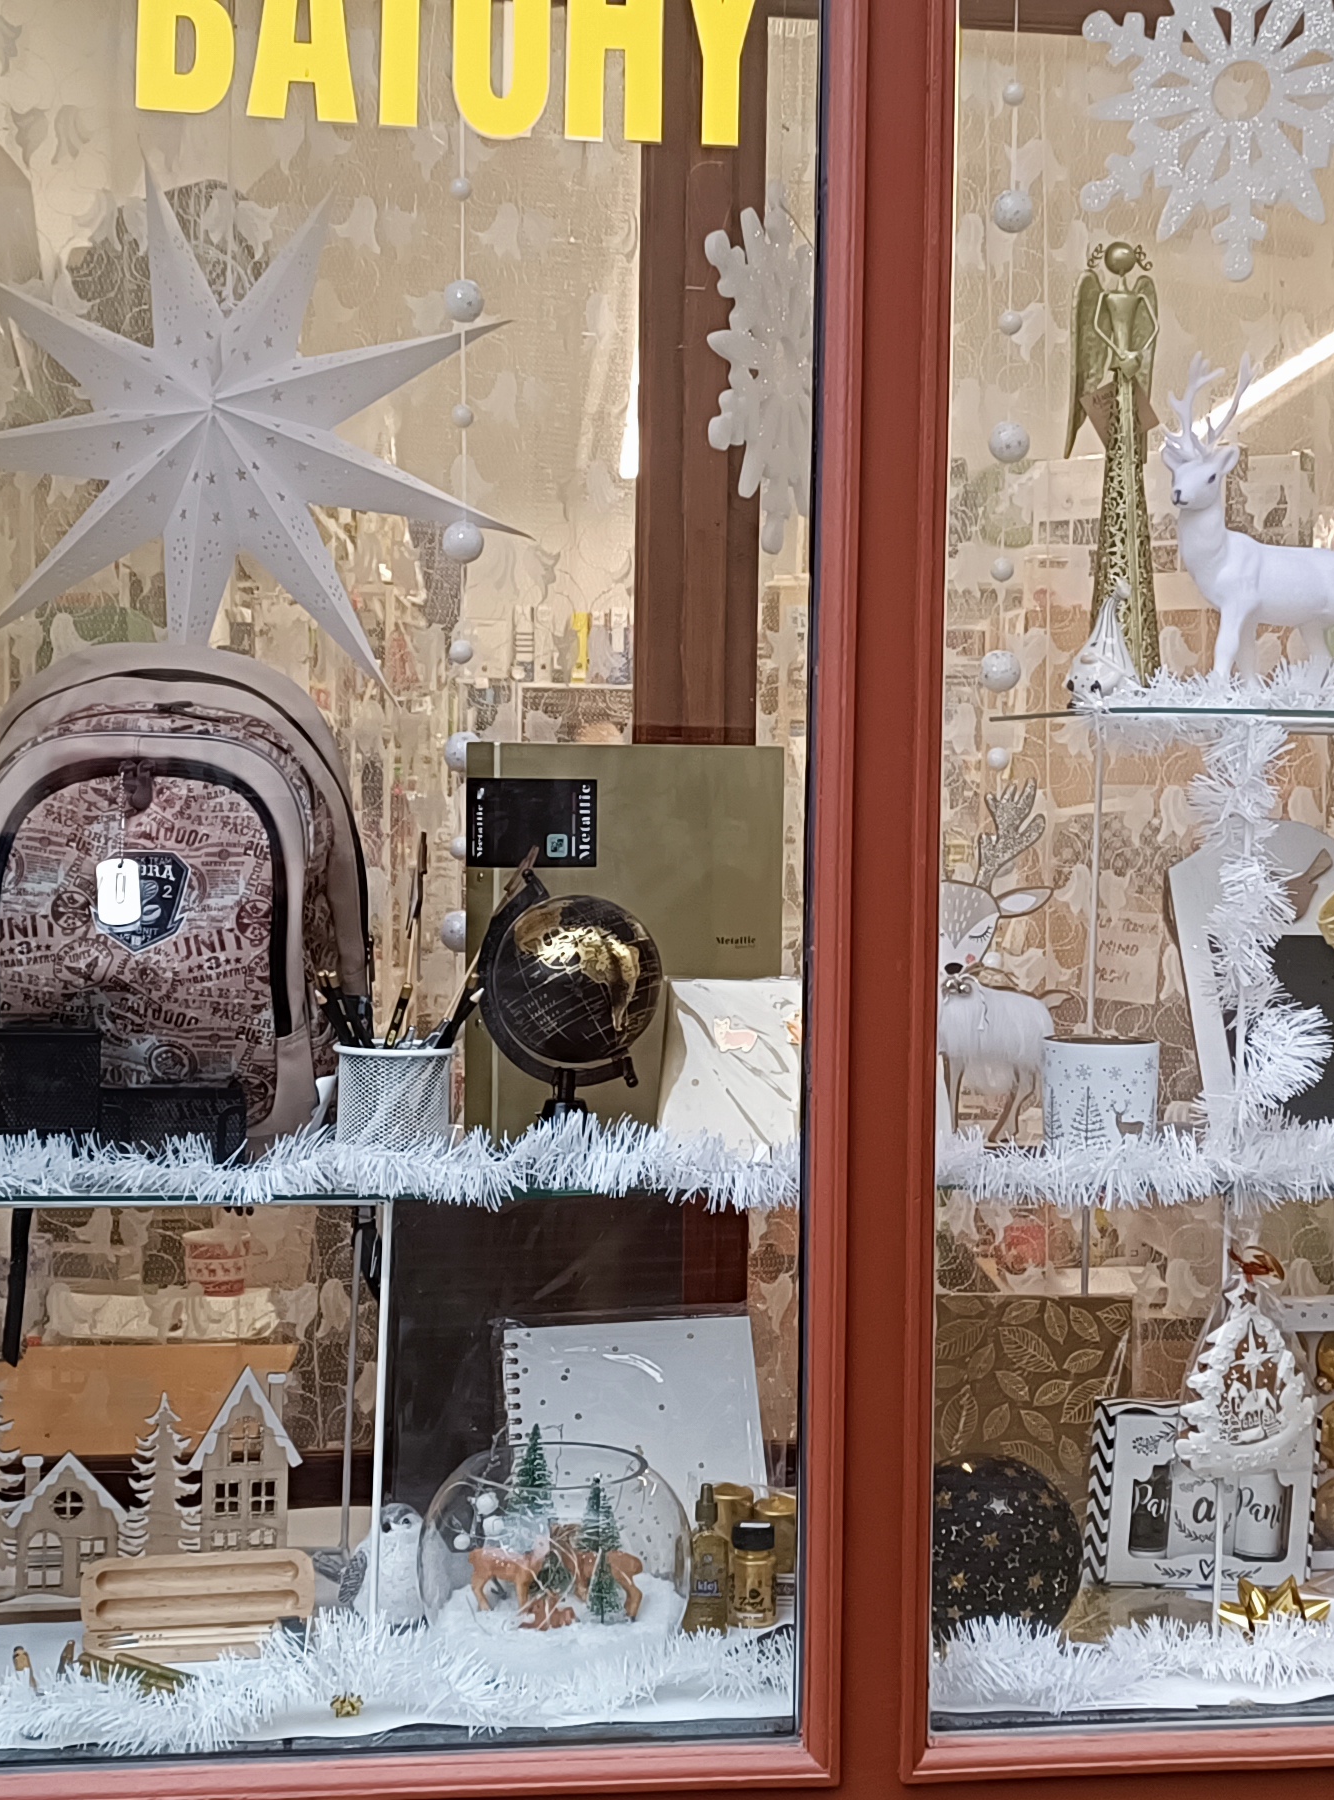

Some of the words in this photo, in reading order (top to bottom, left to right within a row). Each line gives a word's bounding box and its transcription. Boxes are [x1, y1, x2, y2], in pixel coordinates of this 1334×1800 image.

[578, 784, 591, 860] Metallic
[162, 885, 172, 898] 2
[173, 929, 243, 962] UNIT
[1192, 1496, 1216, 1524] a
